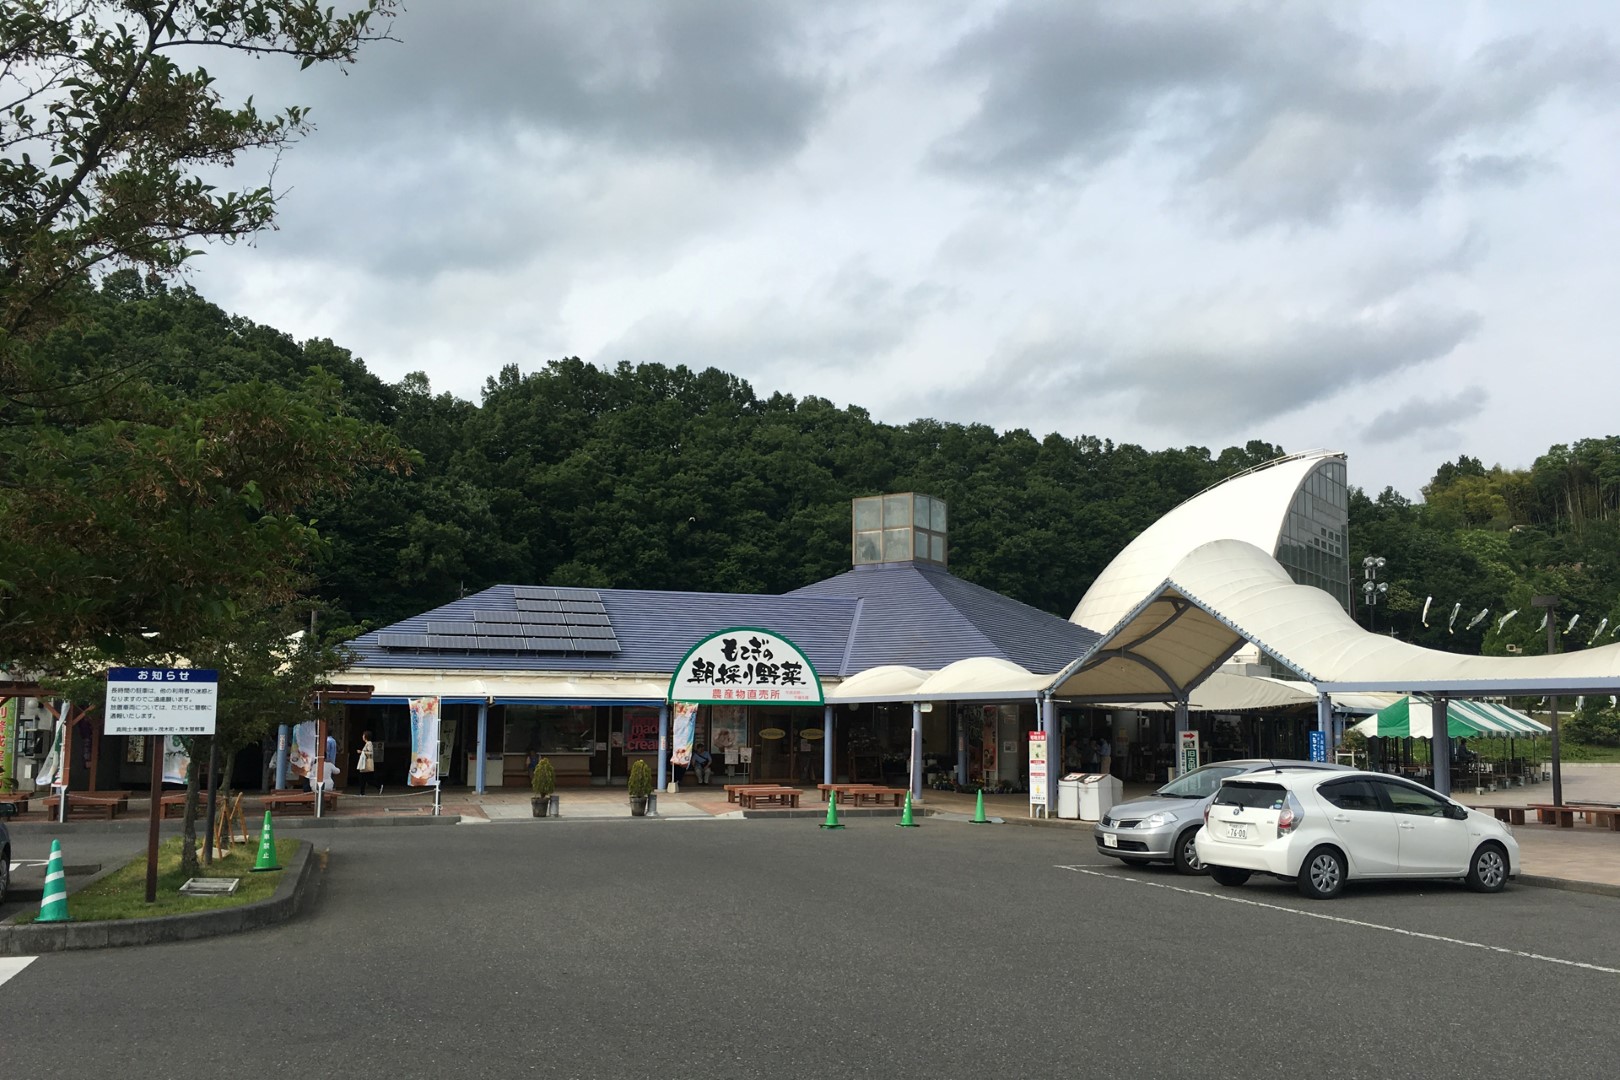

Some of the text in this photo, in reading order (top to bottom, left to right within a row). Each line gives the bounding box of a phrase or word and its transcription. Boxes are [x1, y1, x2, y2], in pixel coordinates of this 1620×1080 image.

[720, 636, 774, 661] もてぎの
[137, 670, 190, 681] お知らせ
[687, 657, 807, 686] 朝採り野菜
[711, 688, 781, 700] 農産物直売所
